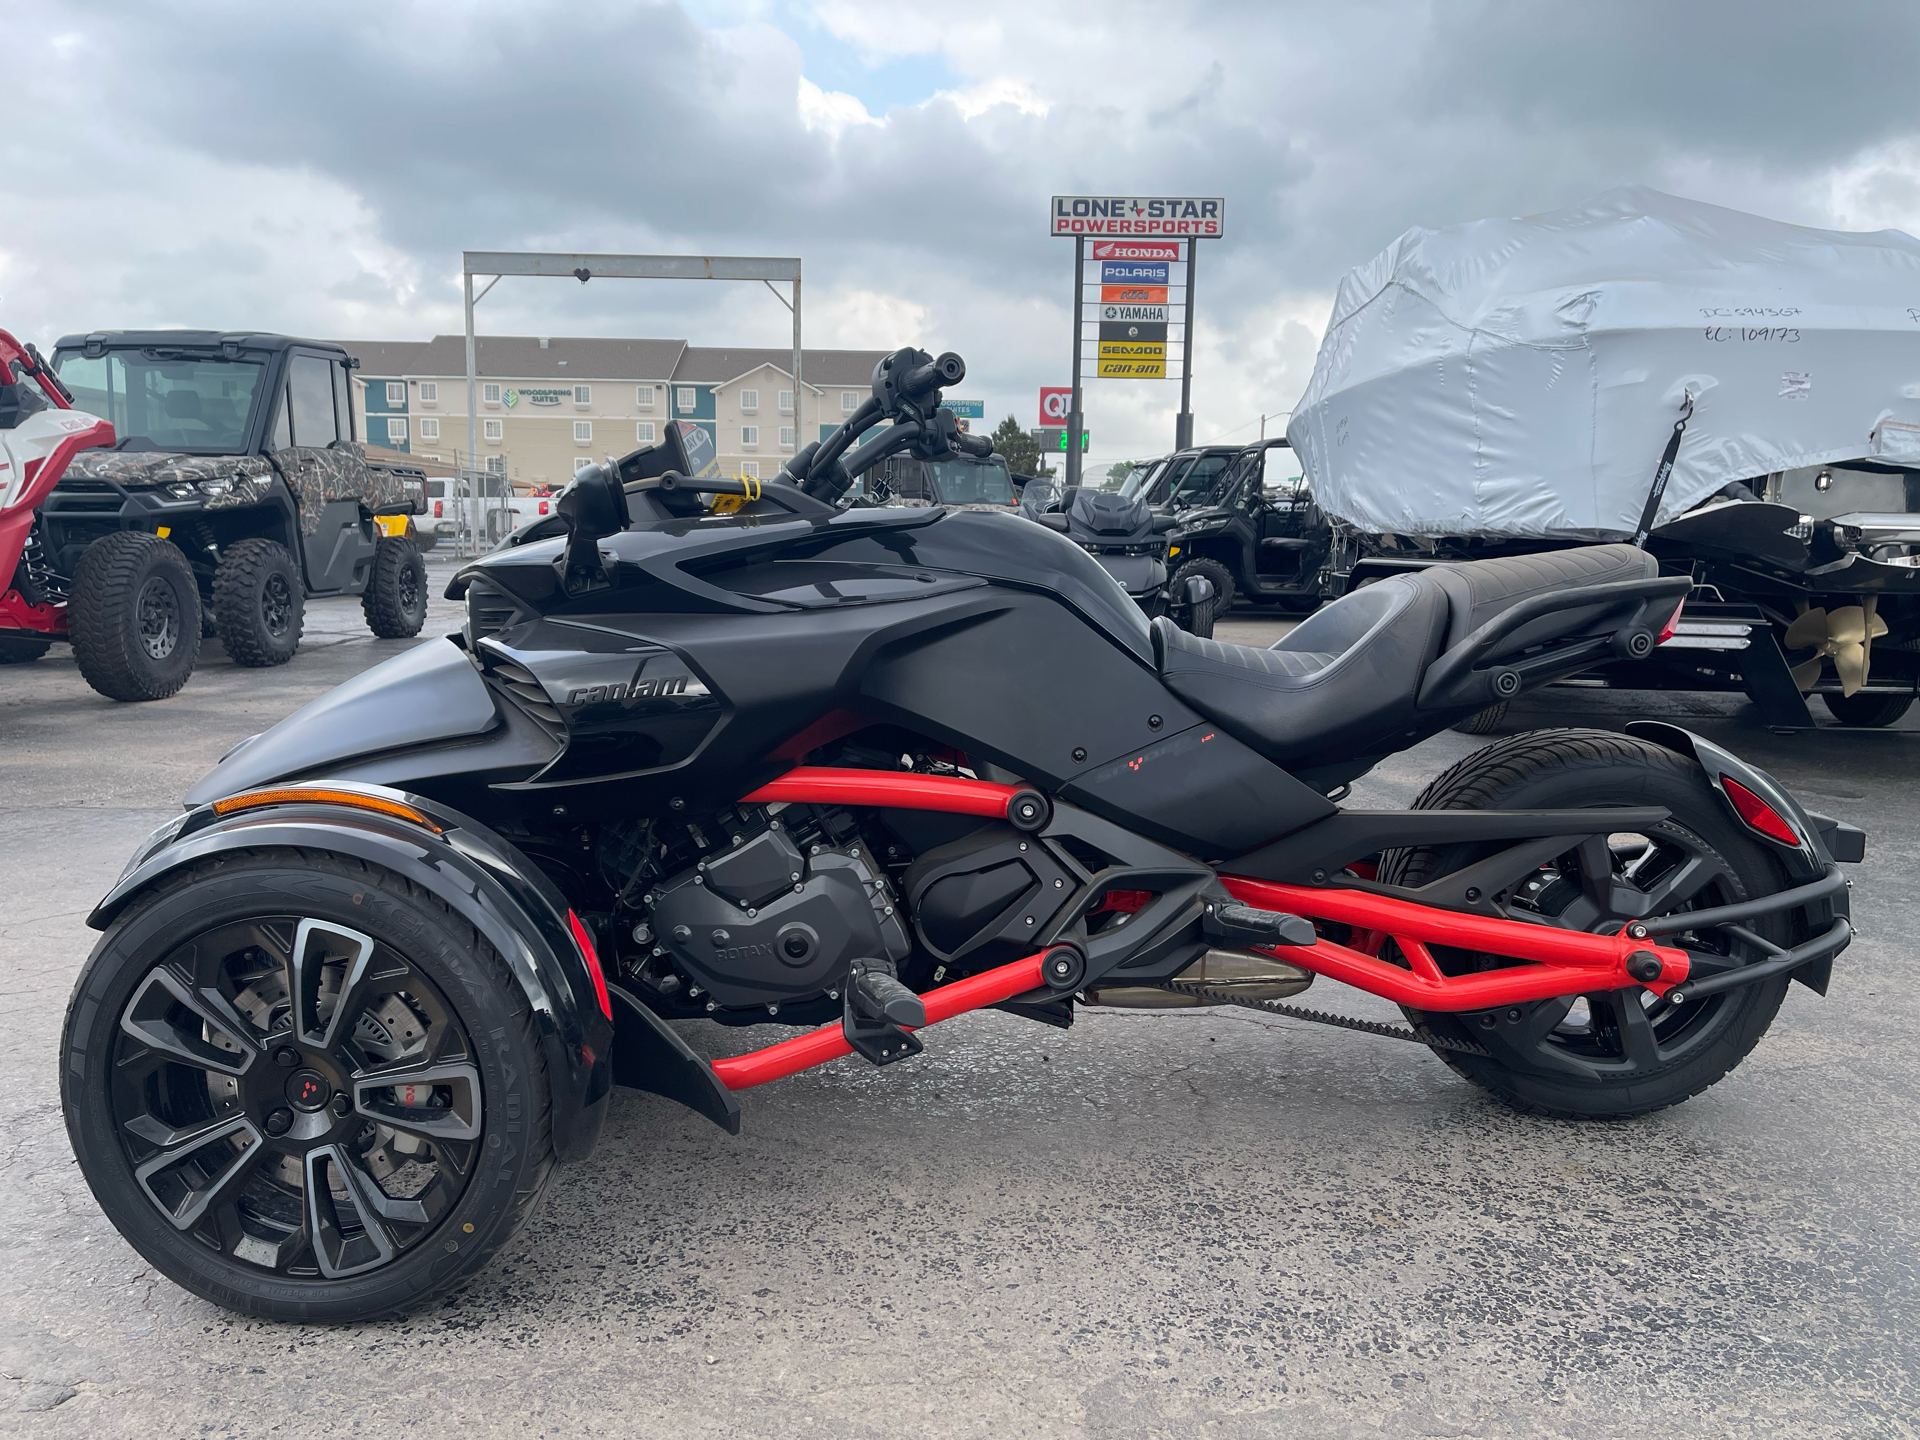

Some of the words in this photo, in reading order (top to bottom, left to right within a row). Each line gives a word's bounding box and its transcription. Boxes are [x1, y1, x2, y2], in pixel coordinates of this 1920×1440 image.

[1057, 198, 1126, 218] LONE
[1147, 199, 1218, 219] STAR
[1057, 218, 1218, 234] POWERSPORTS
[1113, 247, 1177, 258] HONDA
[1104, 267, 1166, 277] POLARIS
[1120, 288, 1150, 300] KTM
[1119, 306, 1164, 320] YAMAHA
[1741, 326, 1801, 343] 109173
[1103, 363, 1161, 374] can-am
[518, 388, 572, 396] WOODSPRING
[531, 395, 560, 403] SUITES
[565, 674, 689, 708] can-am
[715, 942, 773, 963] ROTAX
[489, 1027, 522, 1188] RADIAL
